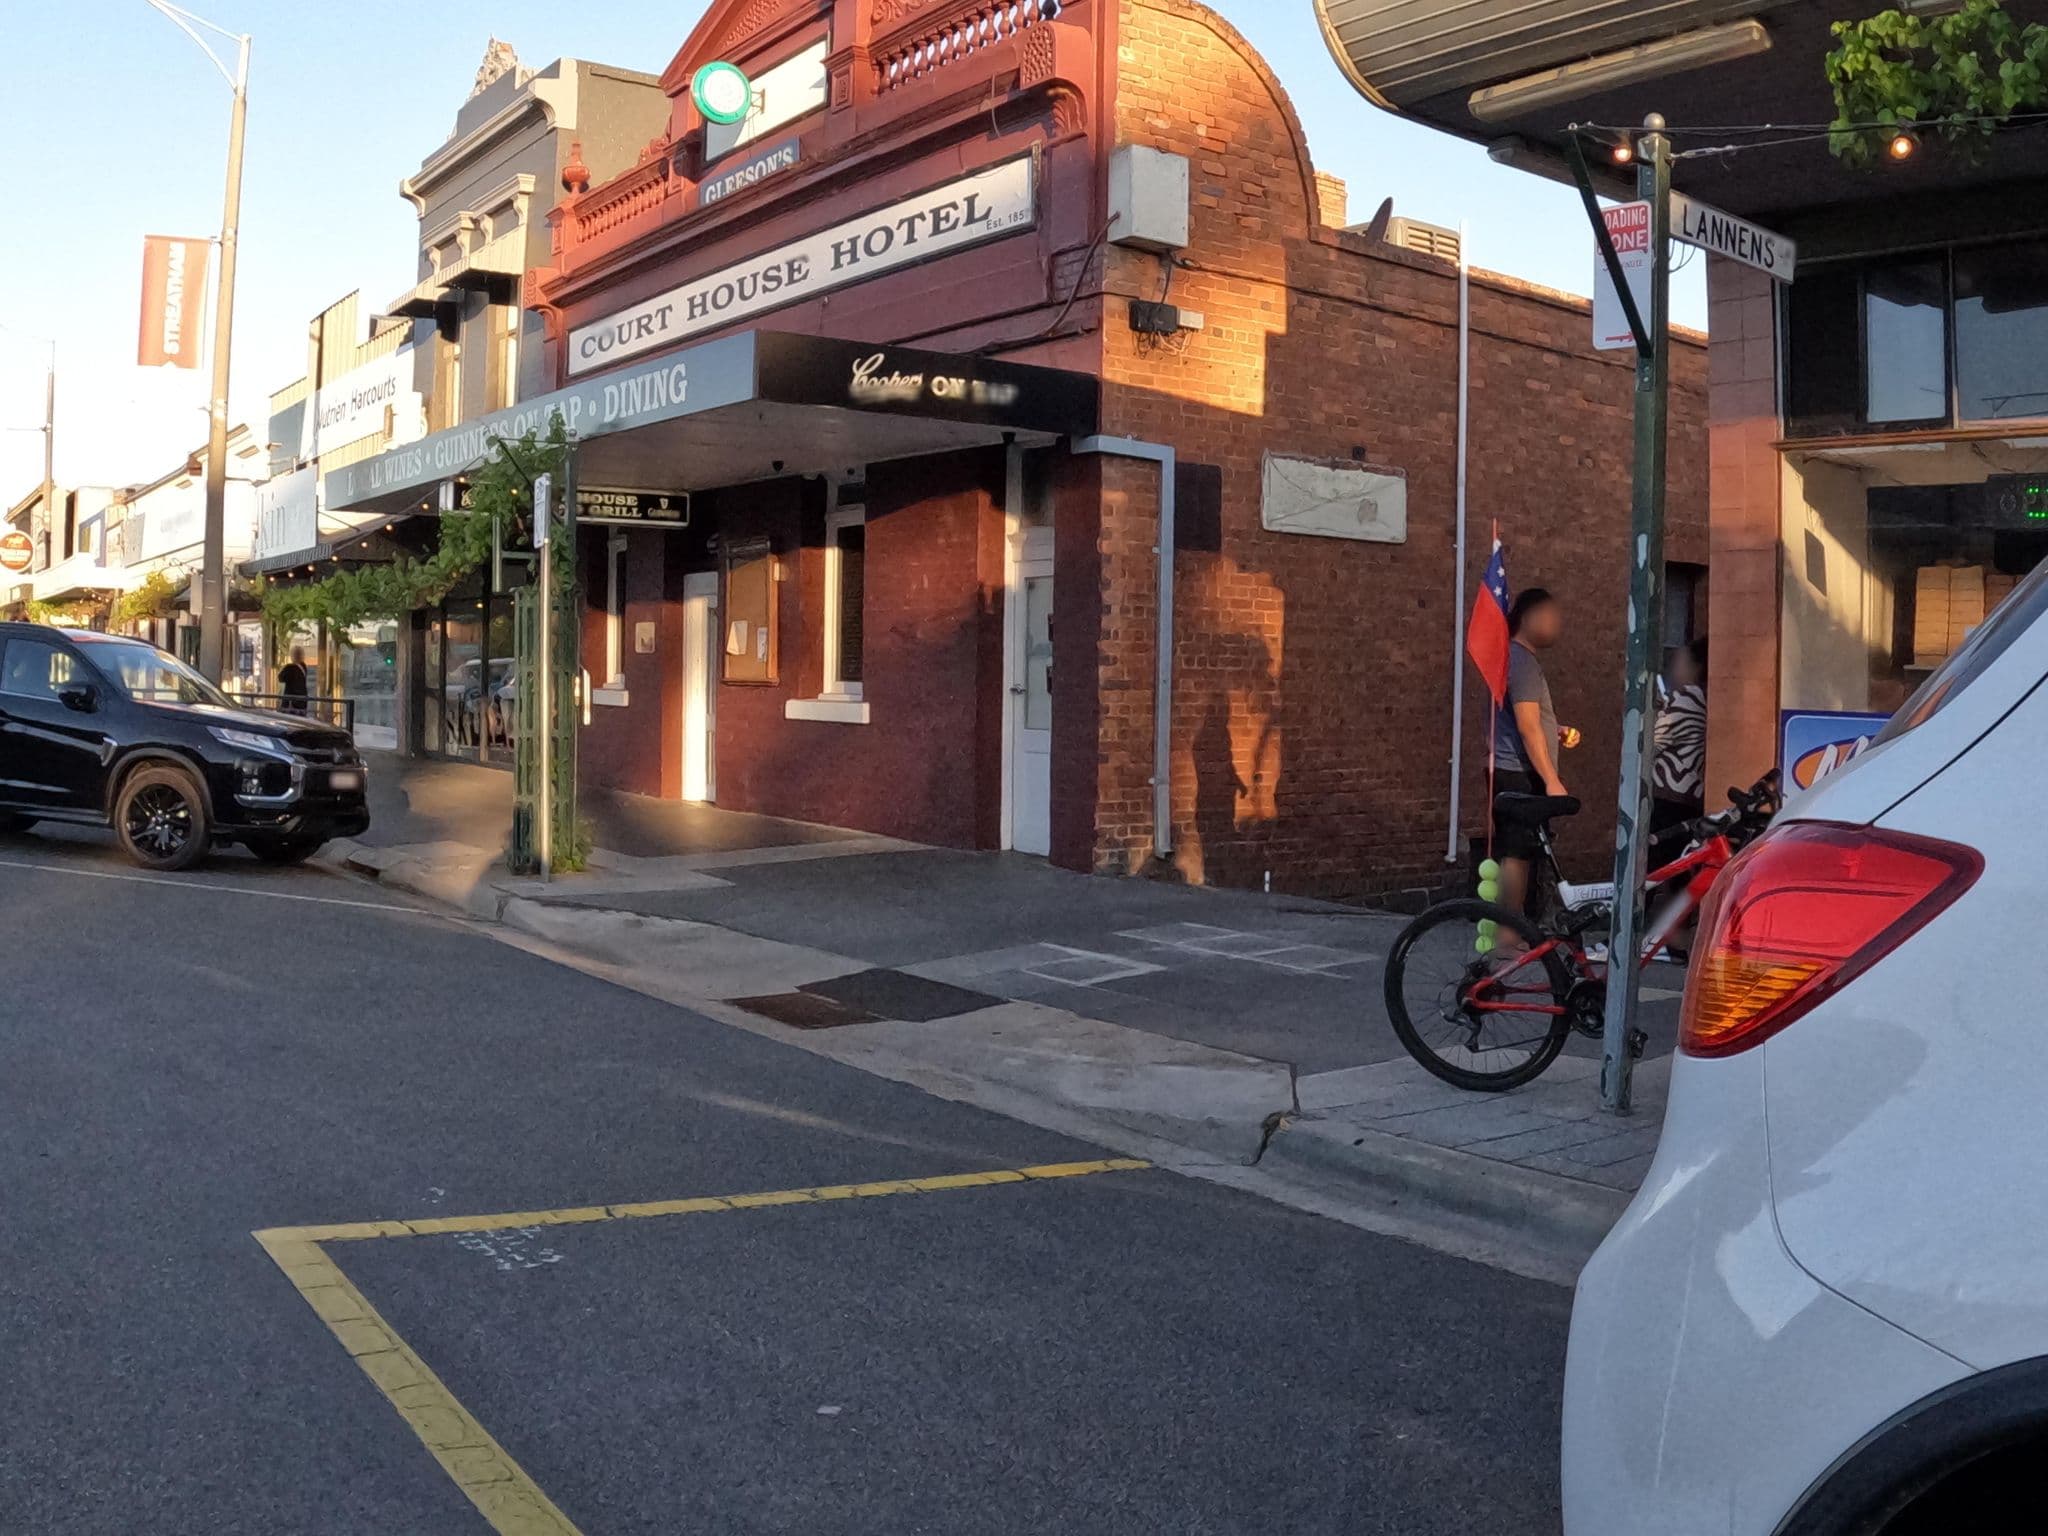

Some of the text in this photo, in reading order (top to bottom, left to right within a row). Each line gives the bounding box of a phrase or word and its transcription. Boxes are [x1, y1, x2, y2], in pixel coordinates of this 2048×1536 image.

[705, 147, 793, 204] GLEESON'S
[1603, 206, 1646, 231] OADING
[1610, 229, 1648, 252] ONE
[1683, 203, 1775, 268] LANNENS
[580, 193, 992, 358] COURT HOUSE HOTEL
[351, 376, 396, 412] Harcourts
[346, 462, 380, 497] LAL
[384, 448, 422, 484] WINES
[604, 363, 688, 422] DINING
